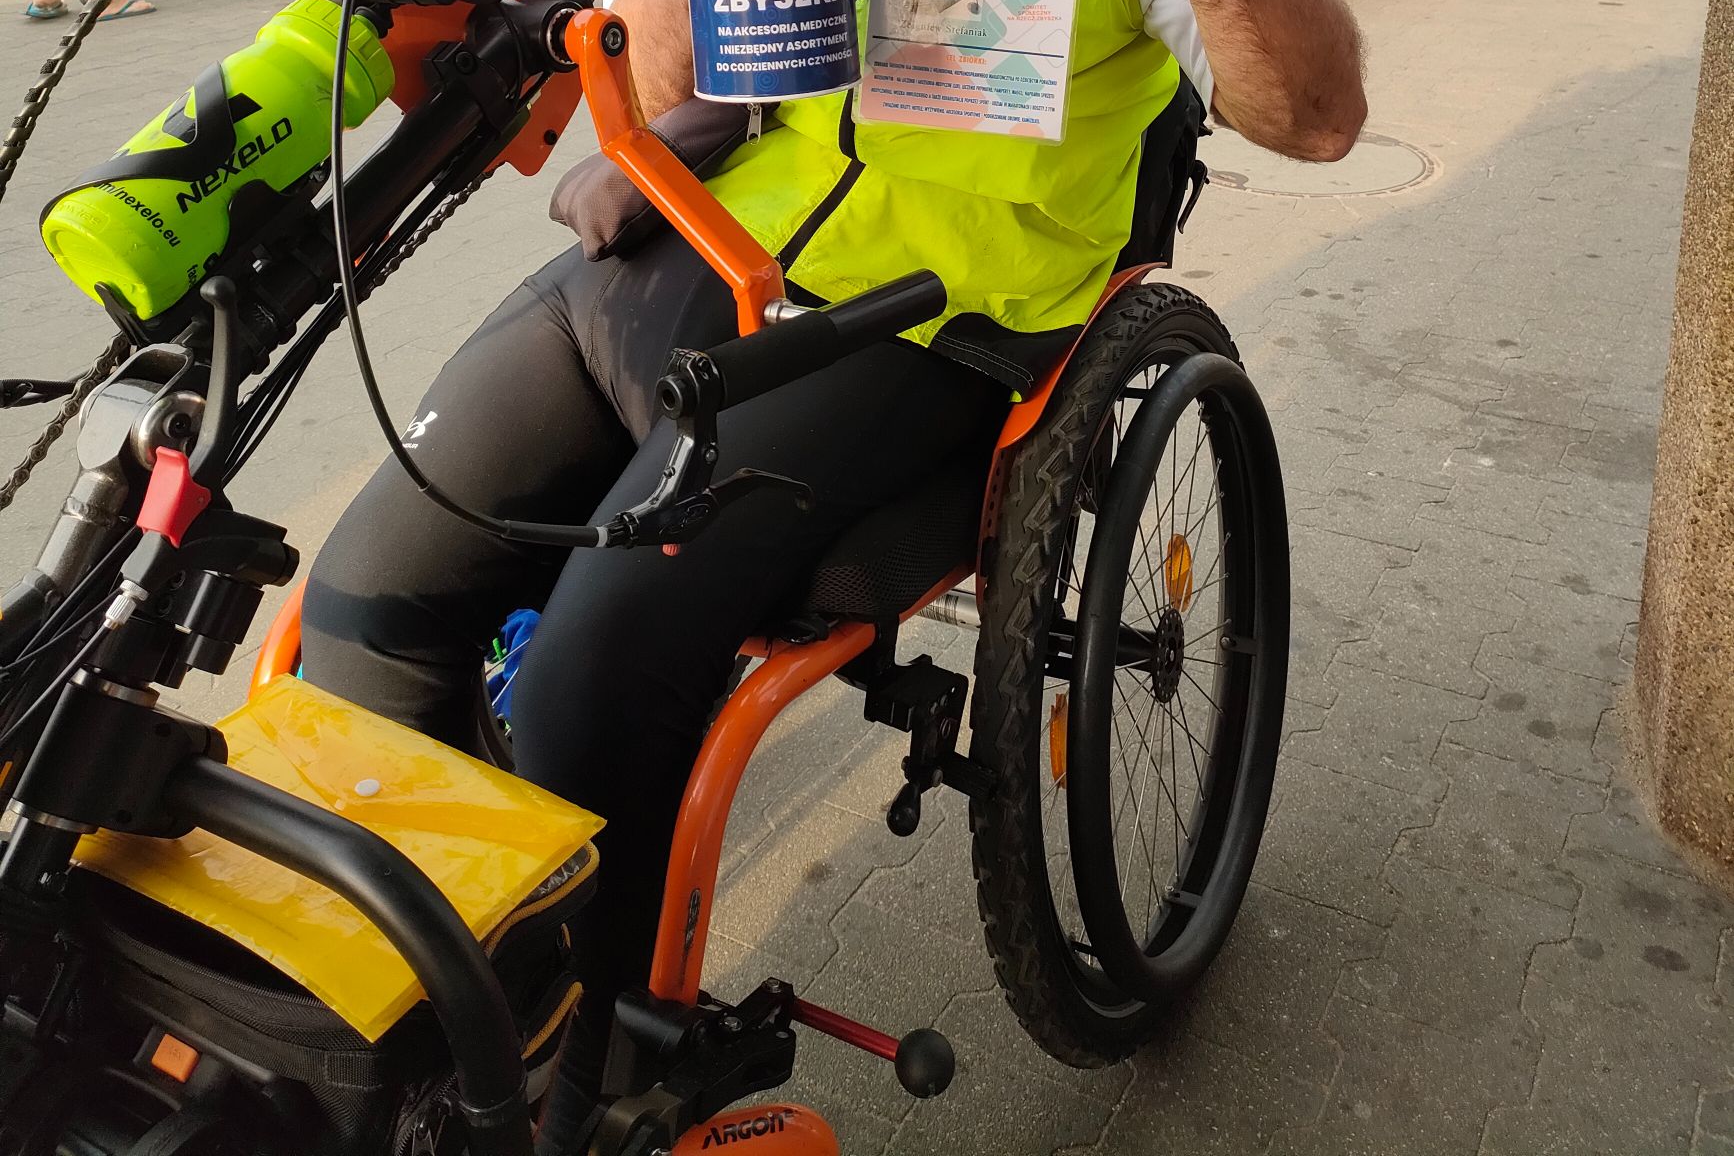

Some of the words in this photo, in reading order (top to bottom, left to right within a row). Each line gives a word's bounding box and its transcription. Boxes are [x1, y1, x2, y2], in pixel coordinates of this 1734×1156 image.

[717, 26, 733, 37] NA
[733, 22, 799, 36] AKCESORIA
[800, 13, 848, 32] MEDYCZNE
[719, 45, 724, 55] I
[724, 42, 784, 57] NIEZBĘDNY
[786, 32, 848, 52] ASORTYMENT
[716, 62, 730, 72] DO
[730, 58, 806, 72] CODZIENNYCH
[807, 48, 853, 66] CZYNNOŚCI
